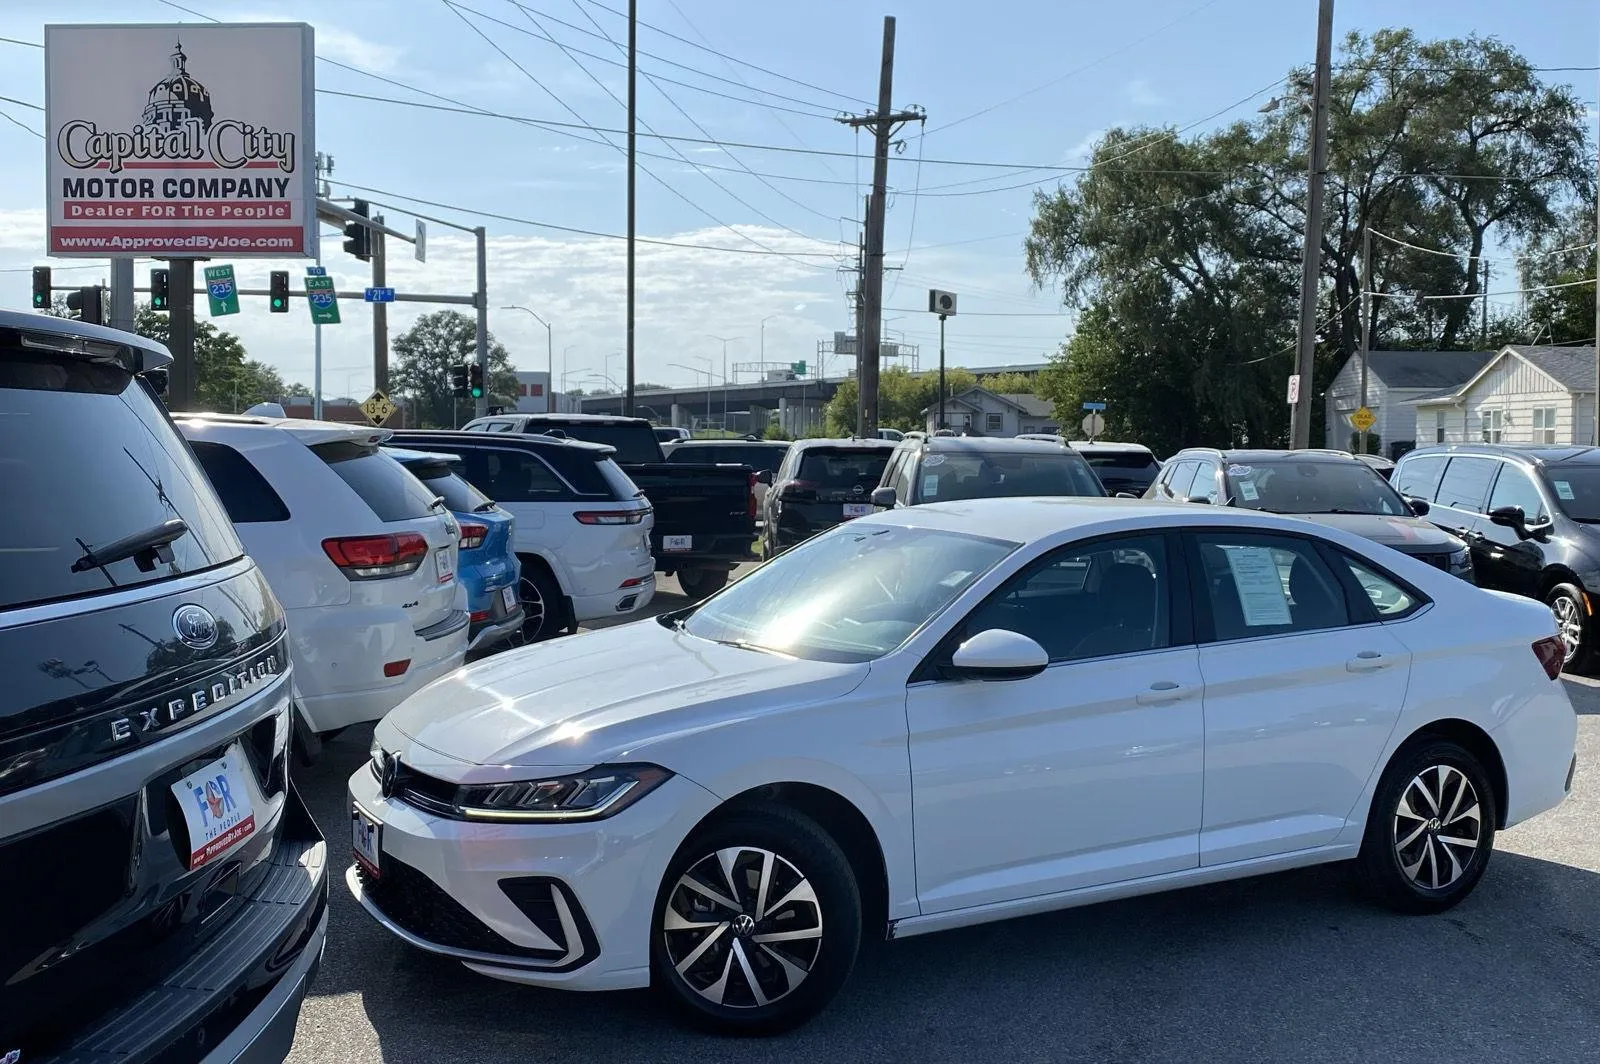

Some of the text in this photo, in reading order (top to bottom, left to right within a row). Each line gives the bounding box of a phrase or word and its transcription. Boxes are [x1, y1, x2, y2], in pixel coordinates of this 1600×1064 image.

[57, 117, 296, 174] Capital City
[63, 177, 290, 199] MOTOR COMPANY
[71, 205, 285, 219] Dealer FOR The People
[60, 235, 294, 250] www.ApprovedByJoe.com
[208, 268, 230, 277] WEST
[212, 282, 232, 295] 235
[308, 279, 330, 287] EAST
[312, 293, 332, 304] 235
[111, 655, 277, 742] EXPEDITION
[193, 775, 236, 827] FOR
[205, 827, 217, 840] THE
